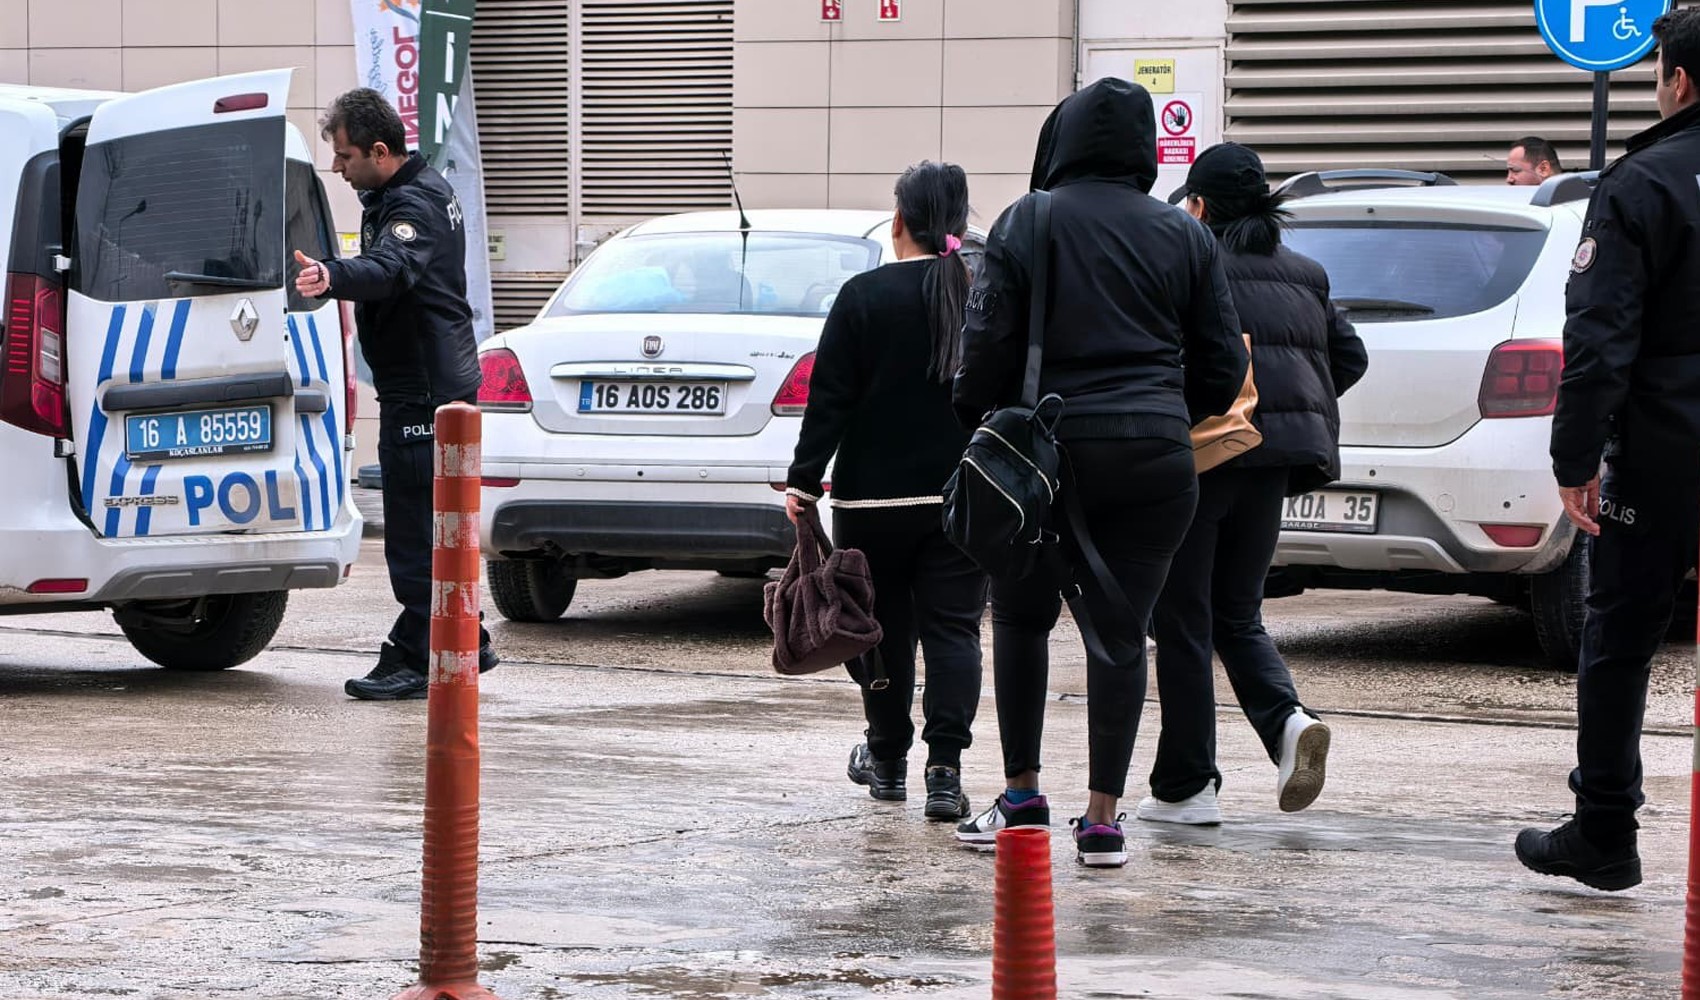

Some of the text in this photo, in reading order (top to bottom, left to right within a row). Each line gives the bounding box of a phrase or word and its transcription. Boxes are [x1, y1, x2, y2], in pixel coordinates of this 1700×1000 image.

[1138, 63, 1171, 75] JENERATÖR
[595, 384, 720, 410] 16 AOS 286
[139, 411, 261, 448] 16 A 85559
[403, 423, 434, 438] POLİ
[103, 496, 179, 507] EXPRESS
[183, 470, 296, 526] POL
[1343, 496, 1372, 521] 35
[1599, 497, 1636, 524] OLİS
